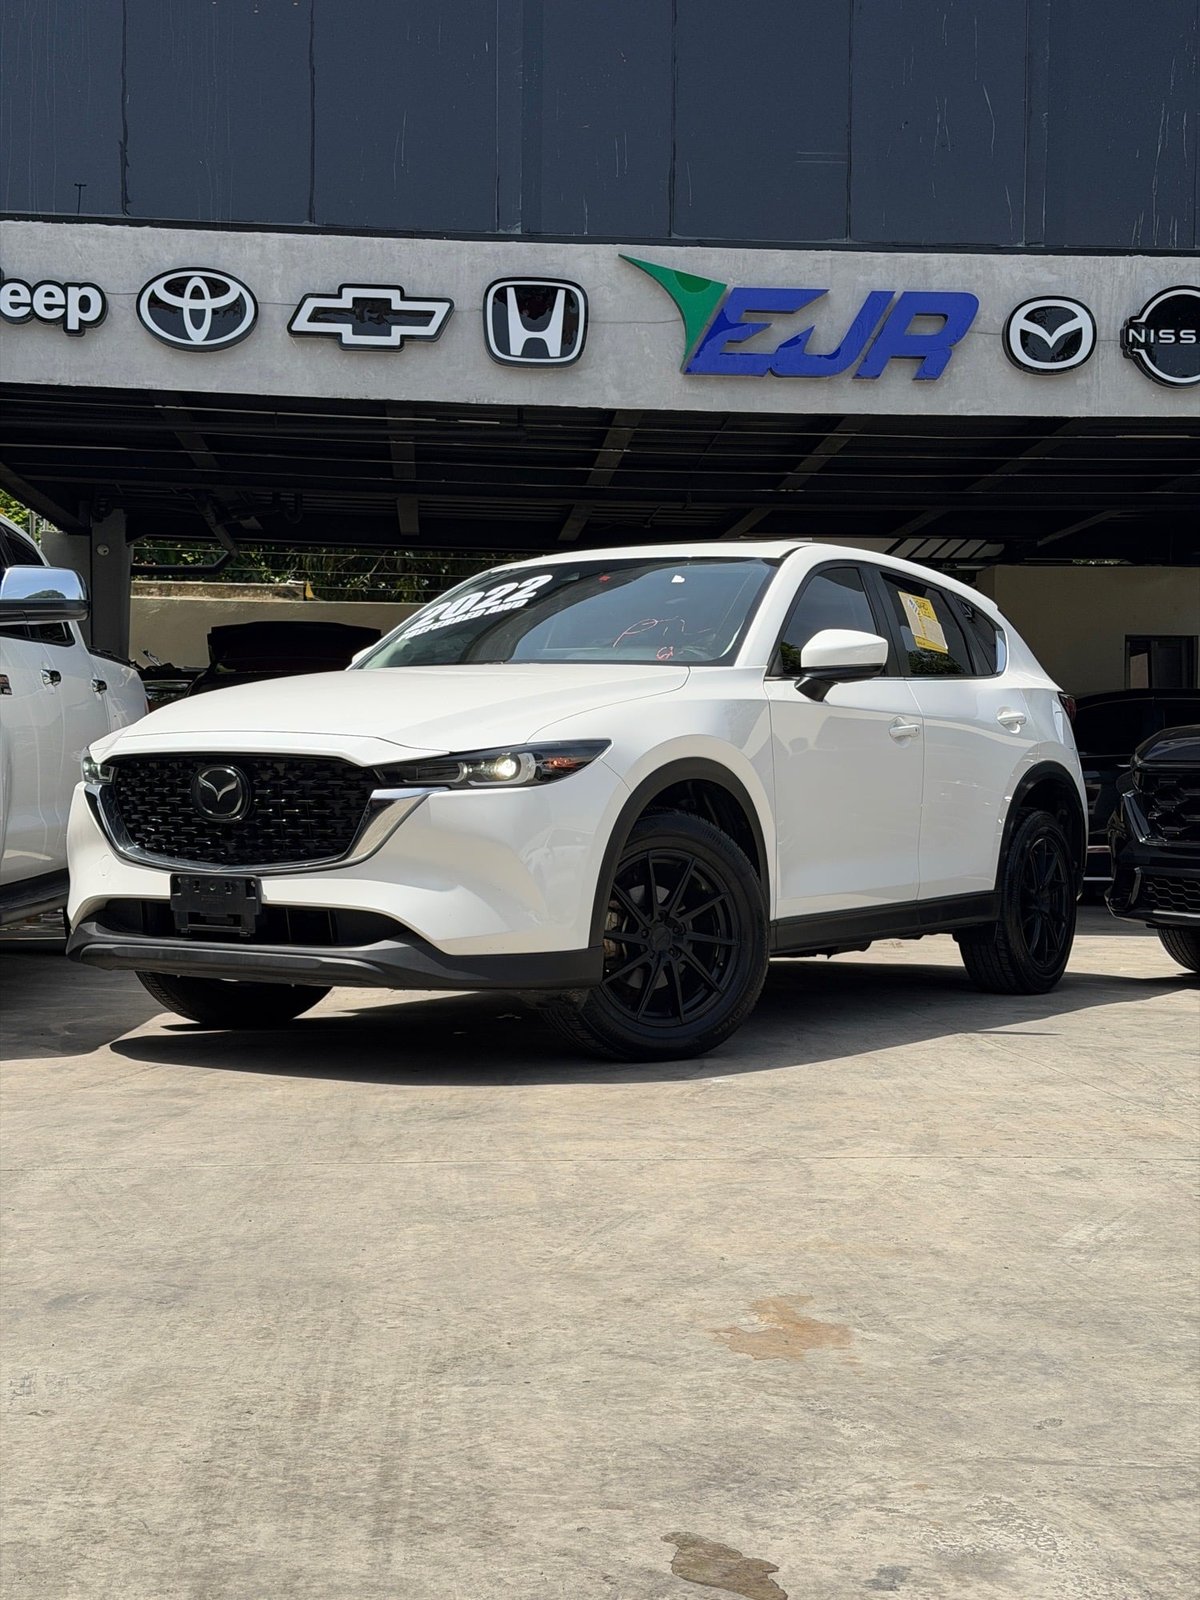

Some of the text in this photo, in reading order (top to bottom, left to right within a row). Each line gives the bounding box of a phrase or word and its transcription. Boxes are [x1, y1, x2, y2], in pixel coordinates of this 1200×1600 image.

[0, 282, 102, 330] eep
[1128, 328, 1200, 344] NISS
[404, 574, 554, 635] 2022
